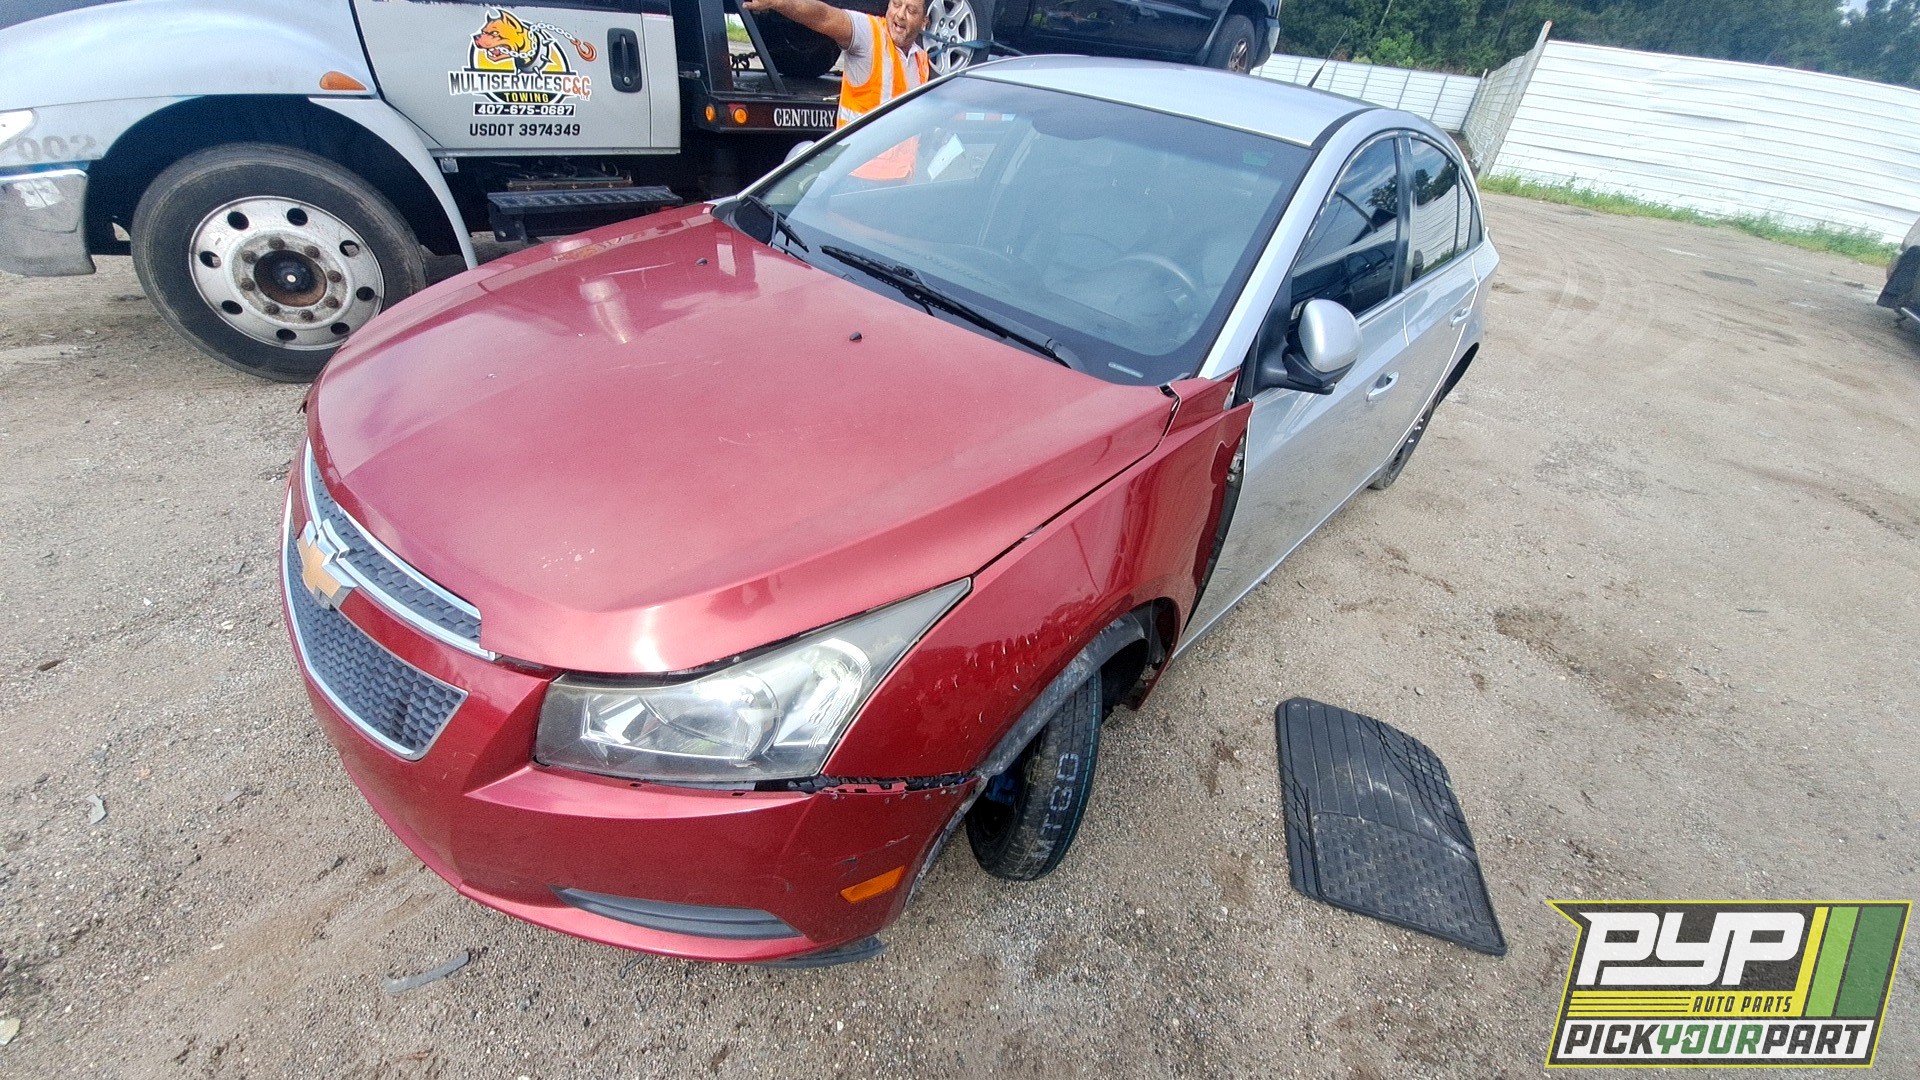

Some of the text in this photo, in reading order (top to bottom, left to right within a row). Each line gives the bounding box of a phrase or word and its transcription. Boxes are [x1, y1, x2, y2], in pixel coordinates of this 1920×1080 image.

[503, 92, 549, 103] TOWING
[477, 104, 573, 116] 407-675-0687
[773, 108, 836, 128] CENTURY
[469, 123, 581, 137] USDOT 3974349
